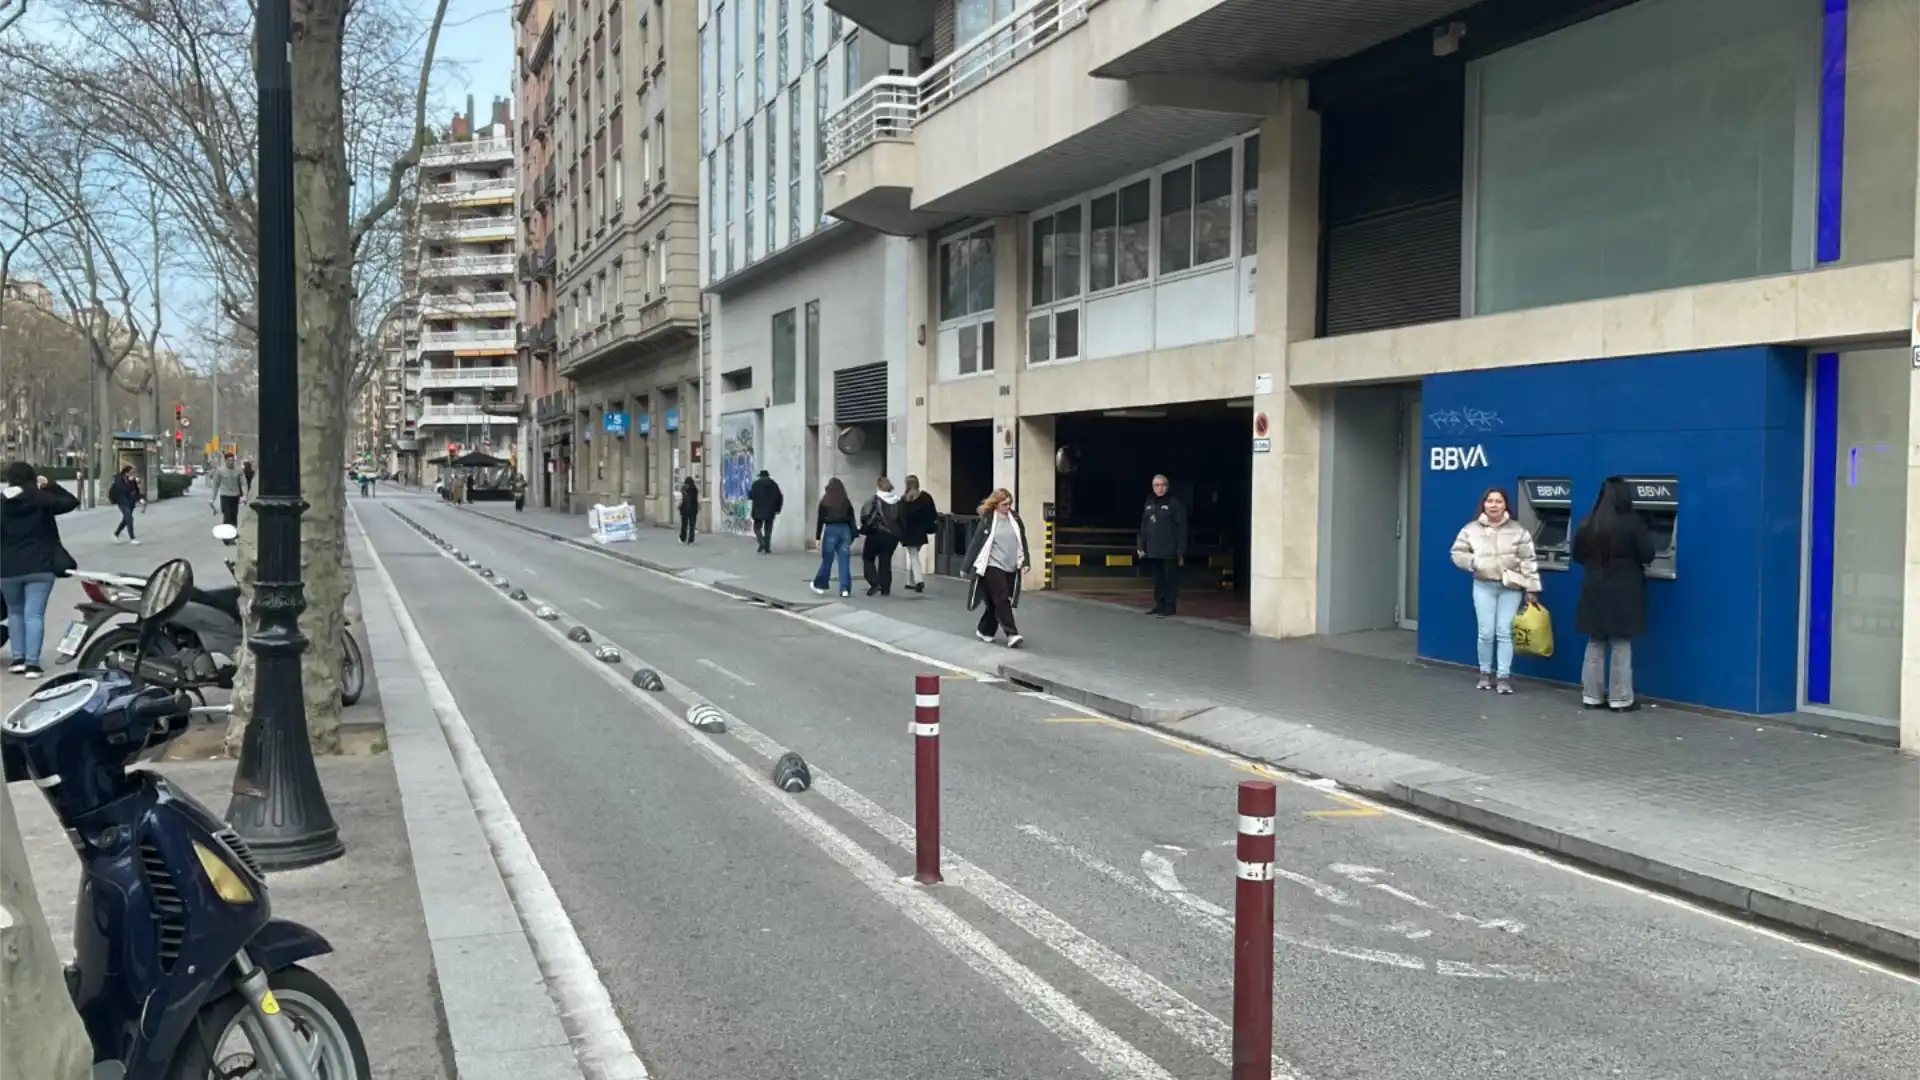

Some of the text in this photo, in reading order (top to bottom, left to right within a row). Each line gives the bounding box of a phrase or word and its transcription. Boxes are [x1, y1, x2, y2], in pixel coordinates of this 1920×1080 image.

[1430, 444, 1488, 470] BBVA
[1536, 485, 1566, 497] BBVA
[1637, 485, 1671, 497] BBVA
